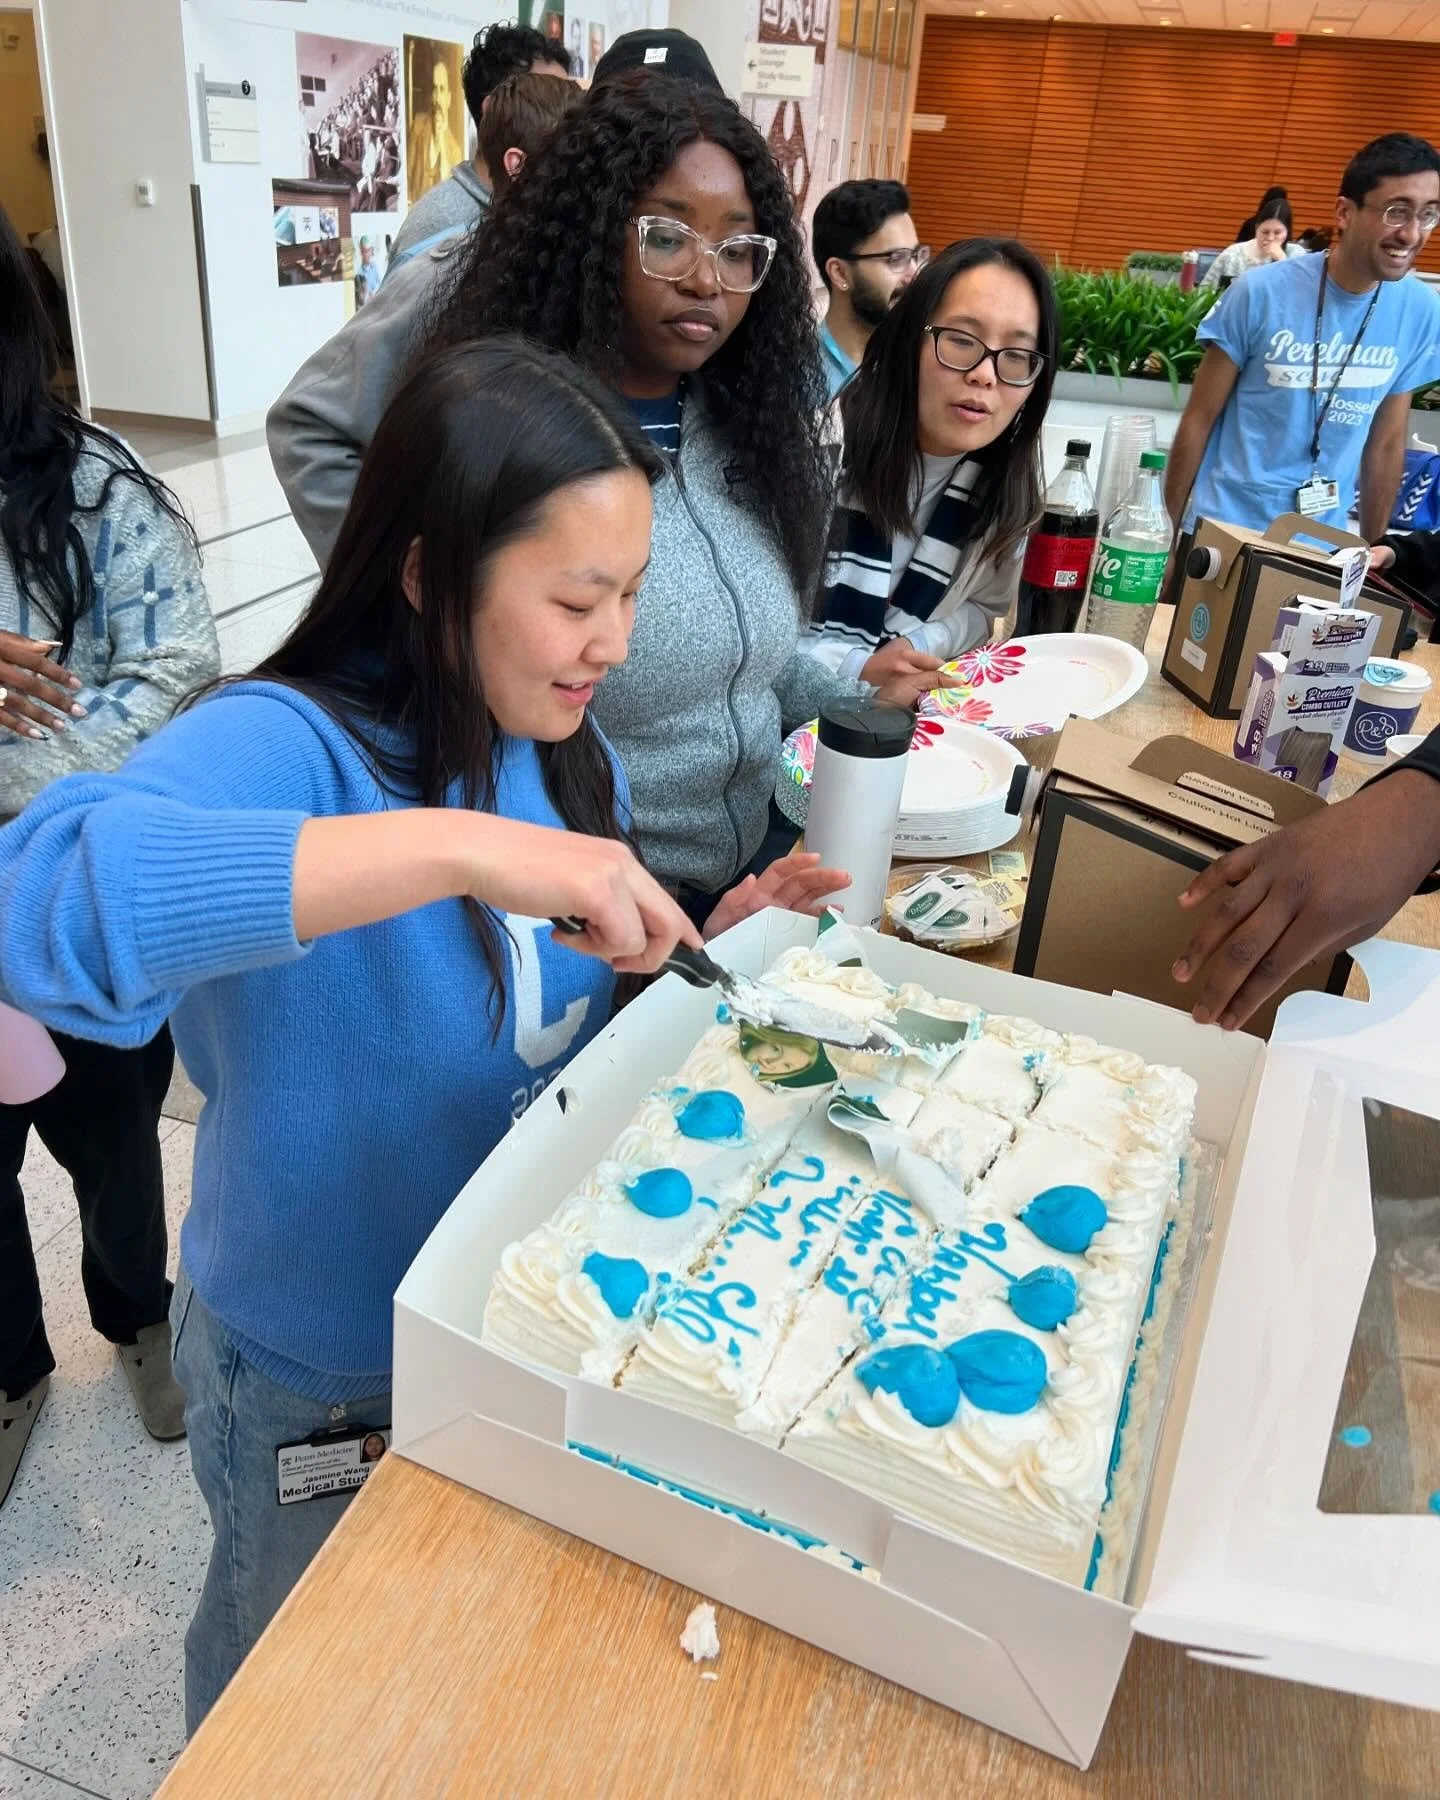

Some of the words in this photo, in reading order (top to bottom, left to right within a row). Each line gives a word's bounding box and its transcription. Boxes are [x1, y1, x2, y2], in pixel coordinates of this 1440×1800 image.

[1264, 329, 1399, 367] Perelman
[1328, 410, 1363, 425] 2023
[1306, 686, 1354, 700] Premium
[1323, 700, 1348, 709] CUTLERY
[1168, 791, 1216, 814] Caution
[302, 1471, 342, 1484] Jasmine
[343, 1466, 370, 1476] Wang
[282, 1480, 335, 1498] Medical
